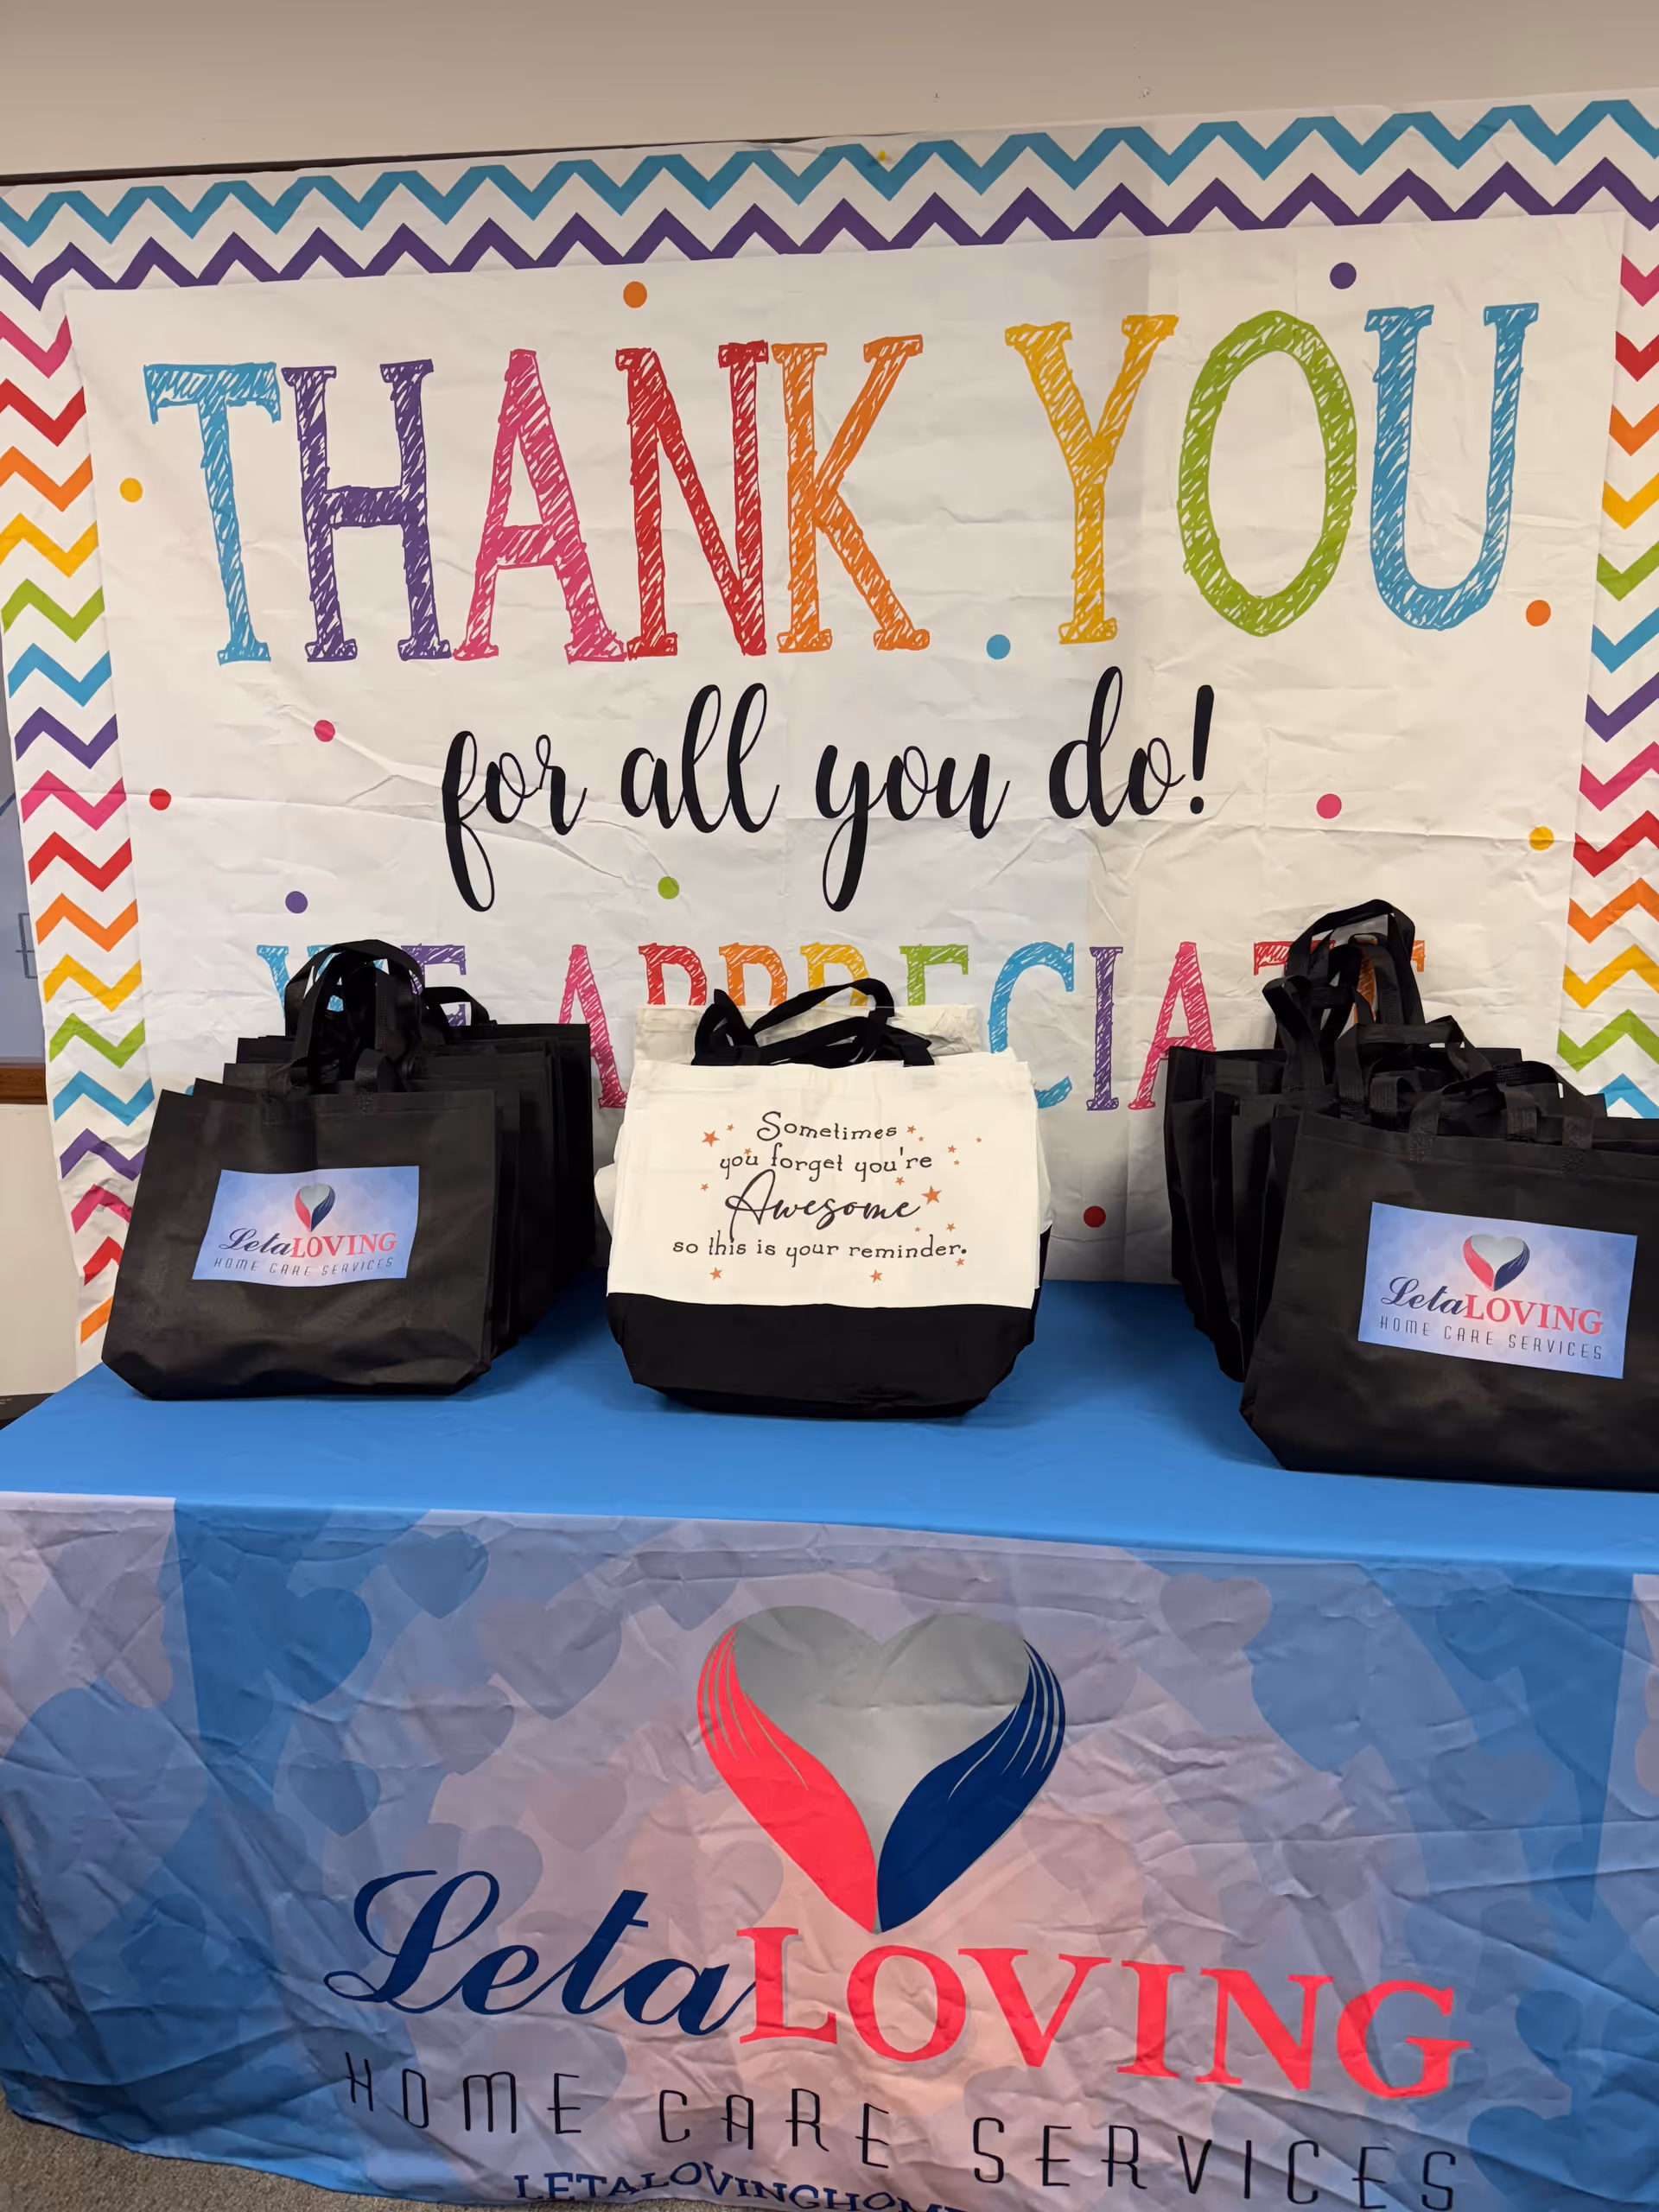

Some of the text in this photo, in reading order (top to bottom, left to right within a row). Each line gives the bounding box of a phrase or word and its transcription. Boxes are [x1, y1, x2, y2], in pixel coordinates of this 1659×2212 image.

[143, 302, 1539, 664] THANK YOU
[442, 666, 1215, 912] for all you do!
[757, 1111, 897, 1141] Sometimes
[720, 1142, 932, 1182] you forget you're
[725, 1169, 920, 1242] Awesome
[214, 1257, 394, 1276] HOME CARE SERVICES
[673, 1230, 967, 1268] so this is your reminder.
[1380, 1316, 1602, 1360] HOME CARE SERVICES
[345, 2051, 1456, 2211] HOME CARE SERVICES
[514, 2161, 968, 2212] LETALOVINGHO
